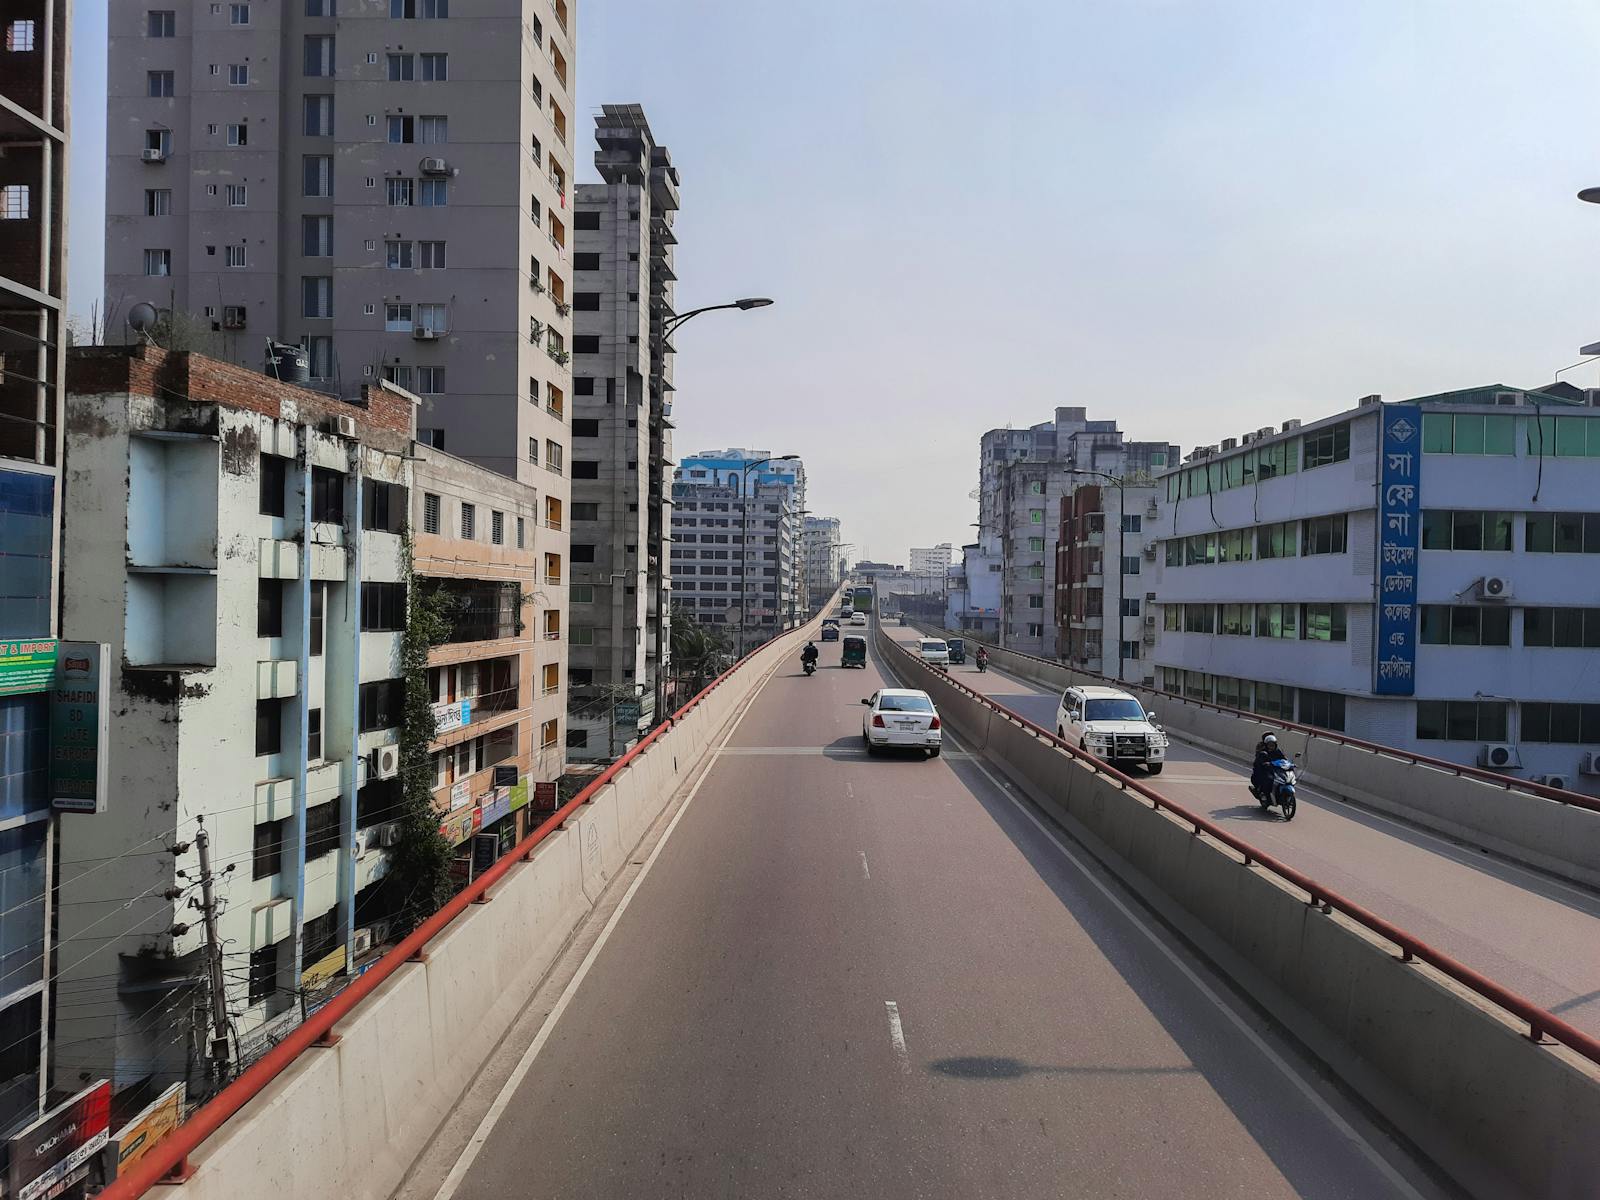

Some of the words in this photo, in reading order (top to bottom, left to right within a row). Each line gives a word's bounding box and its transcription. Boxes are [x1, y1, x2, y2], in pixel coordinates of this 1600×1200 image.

[1387, 451, 1415, 536] সাফেনা
[1384, 571, 1413, 592] ডেন্টাল
[1383, 603, 1411, 621] কলেজ
[11, 644, 18, 655] &
[20, 642, 56, 654] IMPORT
[1380, 654, 1412, 680] হসপিটাল
[57, 689, 96, 703] SHAFIDI
[35, 1123, 77, 1157] YOKOHAMA
